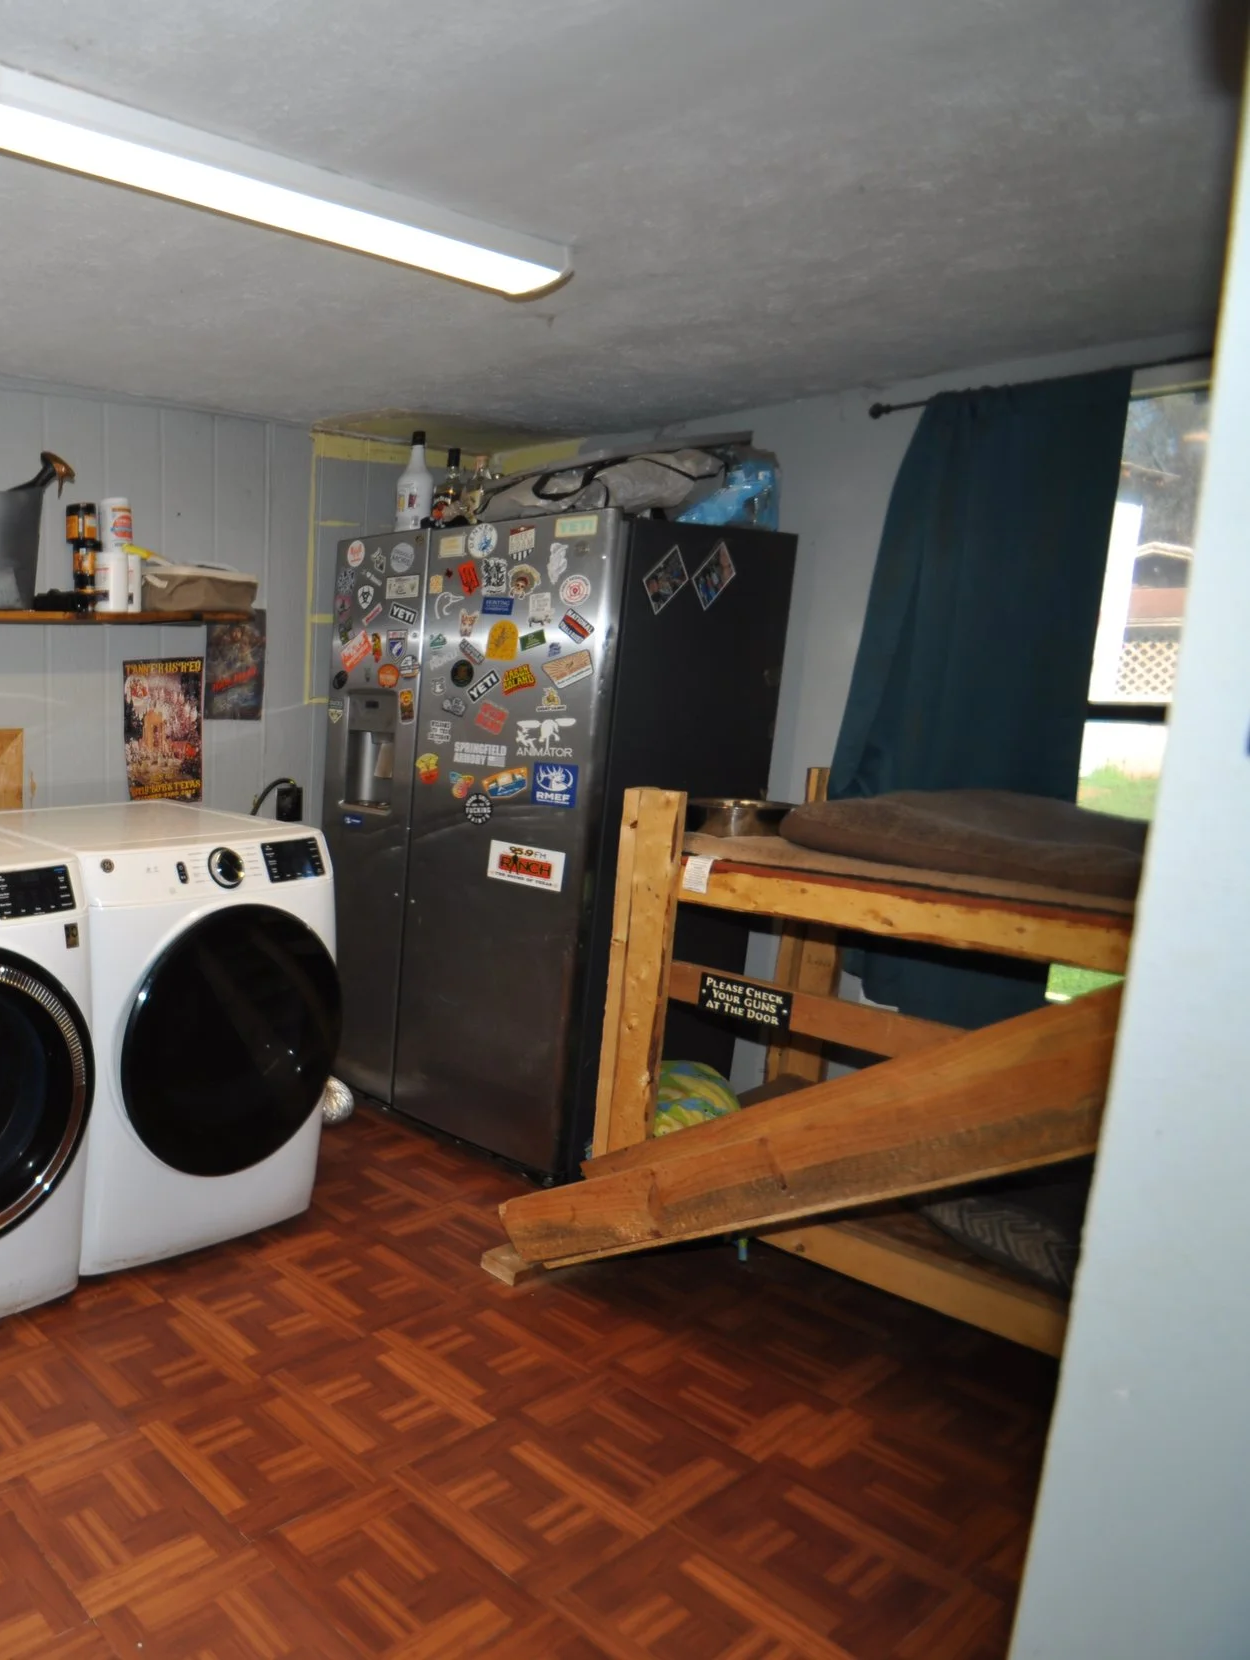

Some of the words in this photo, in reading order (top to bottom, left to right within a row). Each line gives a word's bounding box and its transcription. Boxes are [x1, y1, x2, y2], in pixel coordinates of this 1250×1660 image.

[561, 519, 594, 534] YETI
[392, 604, 416, 623] YETI
[567, 609, 594, 633] NATIONAL
[470, 672, 498, 698] YETI
[454, 742, 507, 757] SPRINGFIELD
[516, 747, 573, 757] ANIMATOR
[536, 791, 570, 801] RMEF
[465, 806, 491, 814] FUCKING
[509, 846, 534, 857] 95.9
[535, 851, 547, 859] FM
[706, 976, 744, 995] PLEASE
[745, 987, 784, 1005] CHECK
[712, 988, 740, 1004] YOUR
[744, 998, 777, 1014] GUNS
[705, 999, 721, 1009] AT
[724, 1002, 745, 1016] THE
[747, 1009, 780, 1025] DOOR
